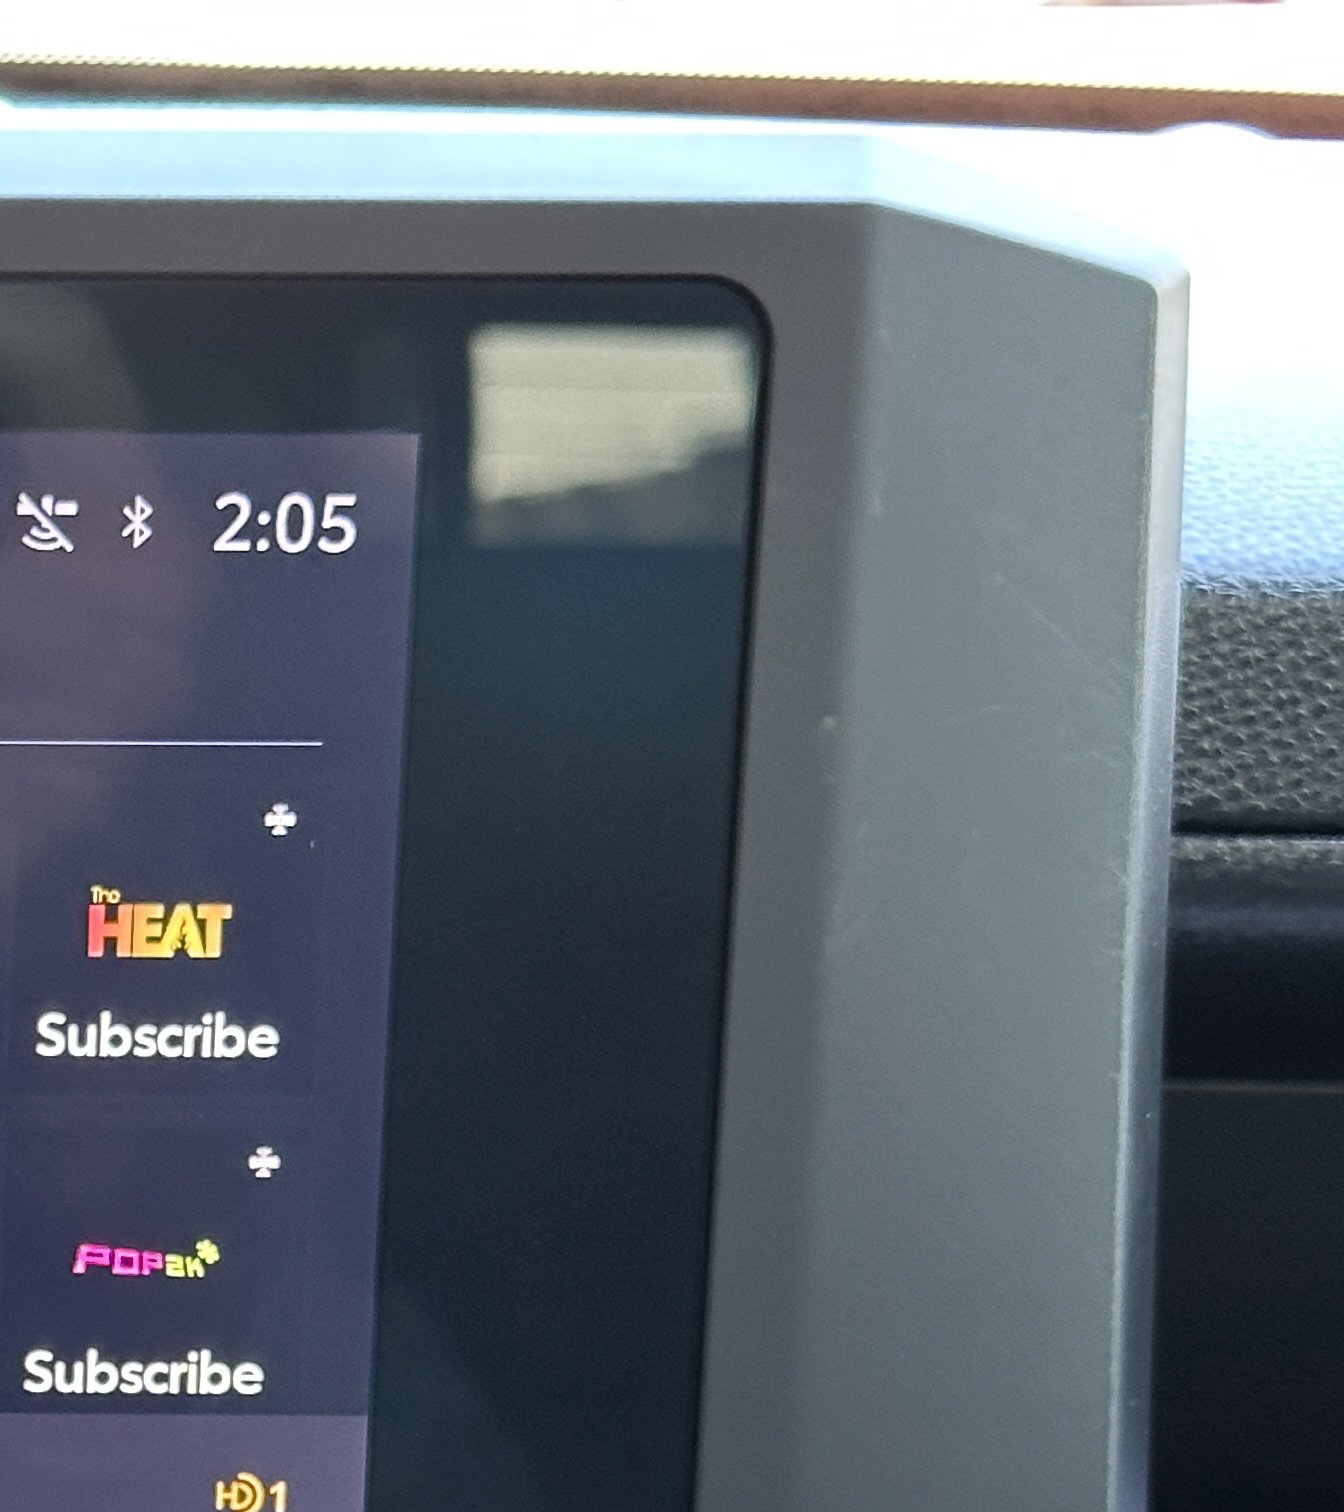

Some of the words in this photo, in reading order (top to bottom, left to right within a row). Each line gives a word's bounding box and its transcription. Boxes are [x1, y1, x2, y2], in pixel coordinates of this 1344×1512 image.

[213, 491, 357, 554] 2:05
[88, 902, 233, 958] HEAT
[35, 1010, 280, 1059] Subscribe
[23, 1347, 265, 1395] Subscribe
